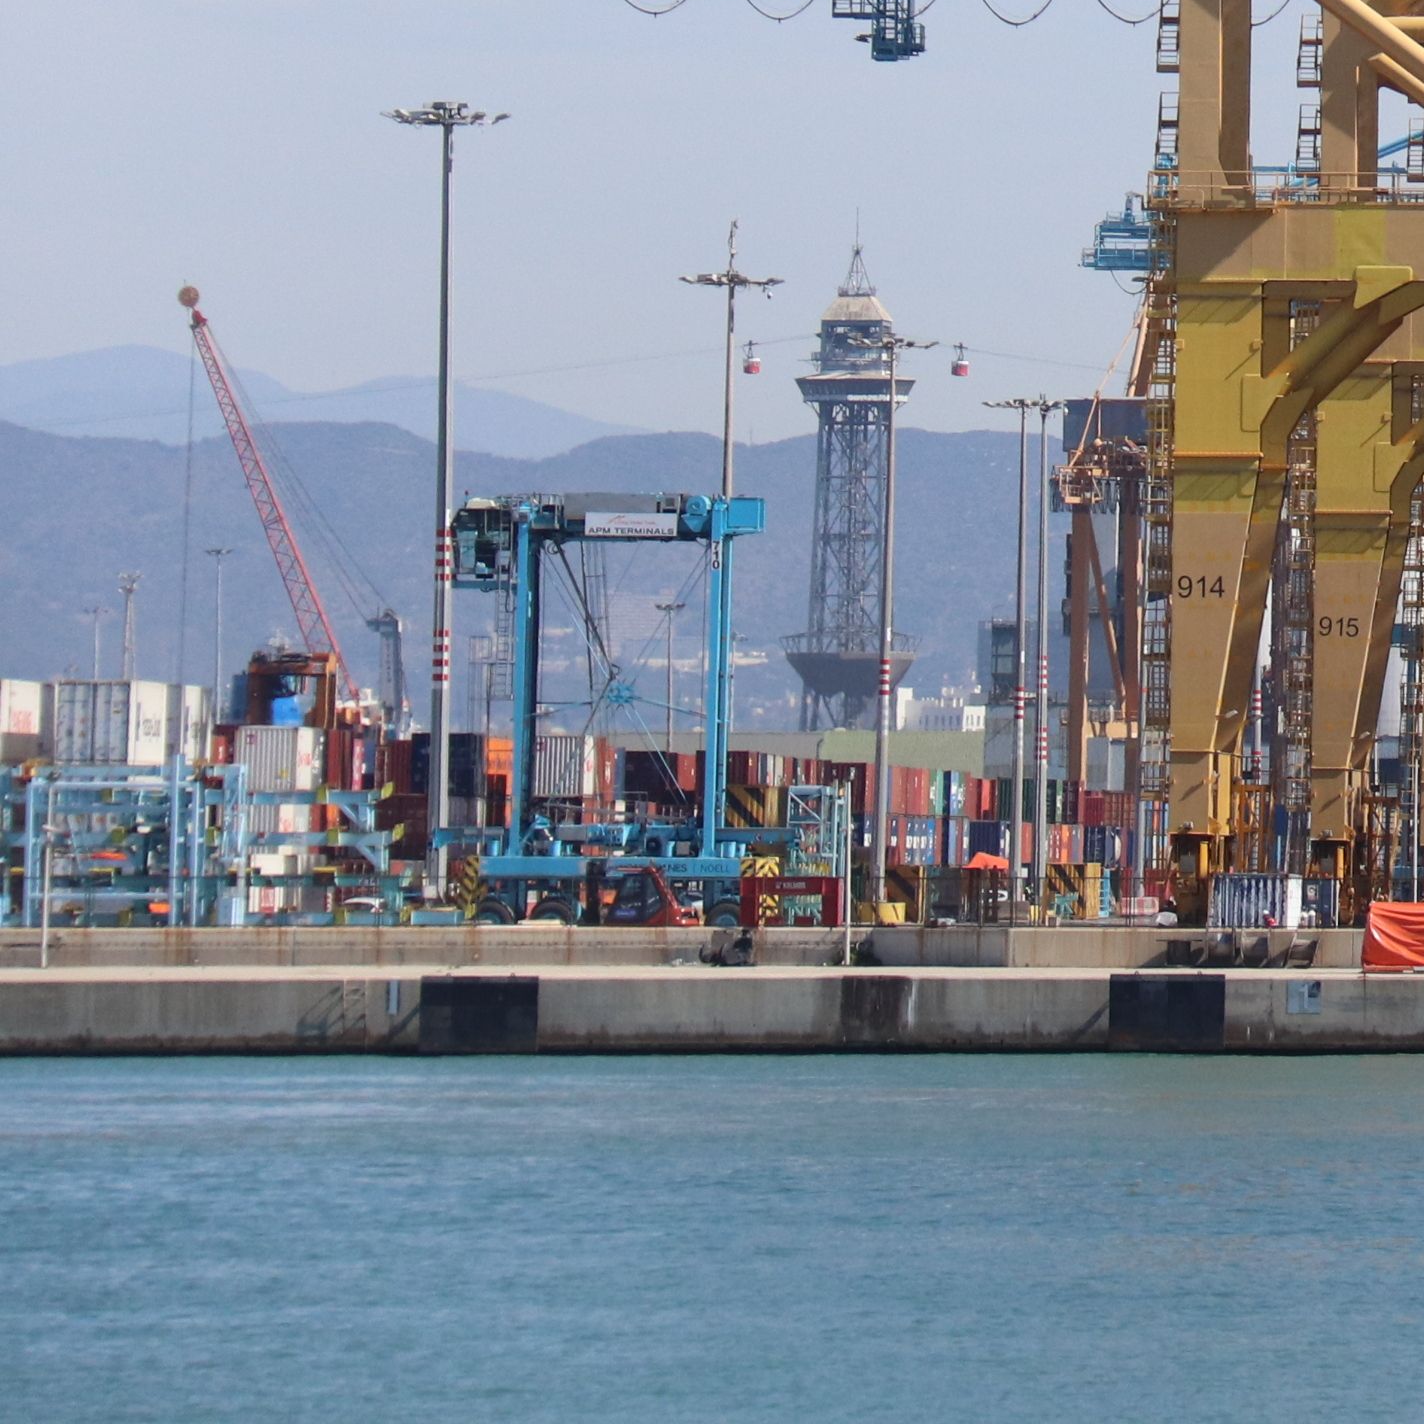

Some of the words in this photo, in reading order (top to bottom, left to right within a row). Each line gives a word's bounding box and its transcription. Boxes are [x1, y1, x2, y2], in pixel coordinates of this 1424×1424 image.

[614, 527, 674, 535] TERMINALS
[1177, 575, 1225, 598] 914
[1318, 616, 1359, 637] 915
[700, 863, 729, 873] NOELL
